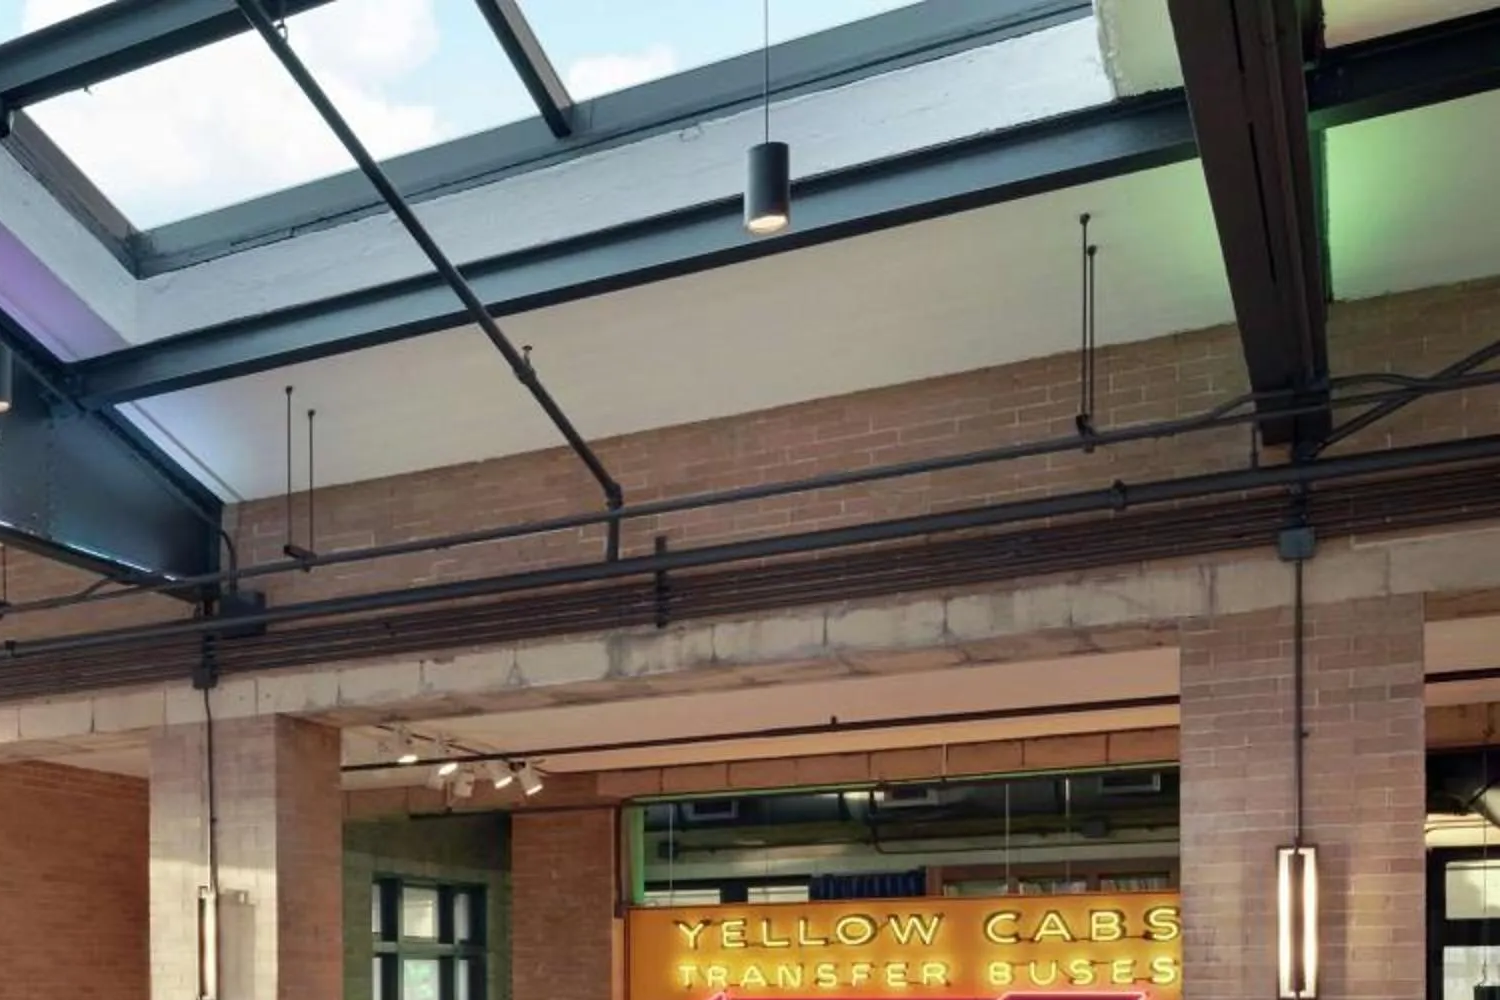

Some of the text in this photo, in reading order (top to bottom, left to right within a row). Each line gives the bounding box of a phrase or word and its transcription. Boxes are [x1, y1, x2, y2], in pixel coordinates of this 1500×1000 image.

[675, 906, 1181, 949] YELLOW CABS
[678, 956, 1177, 989] TRANSFER BUSES
